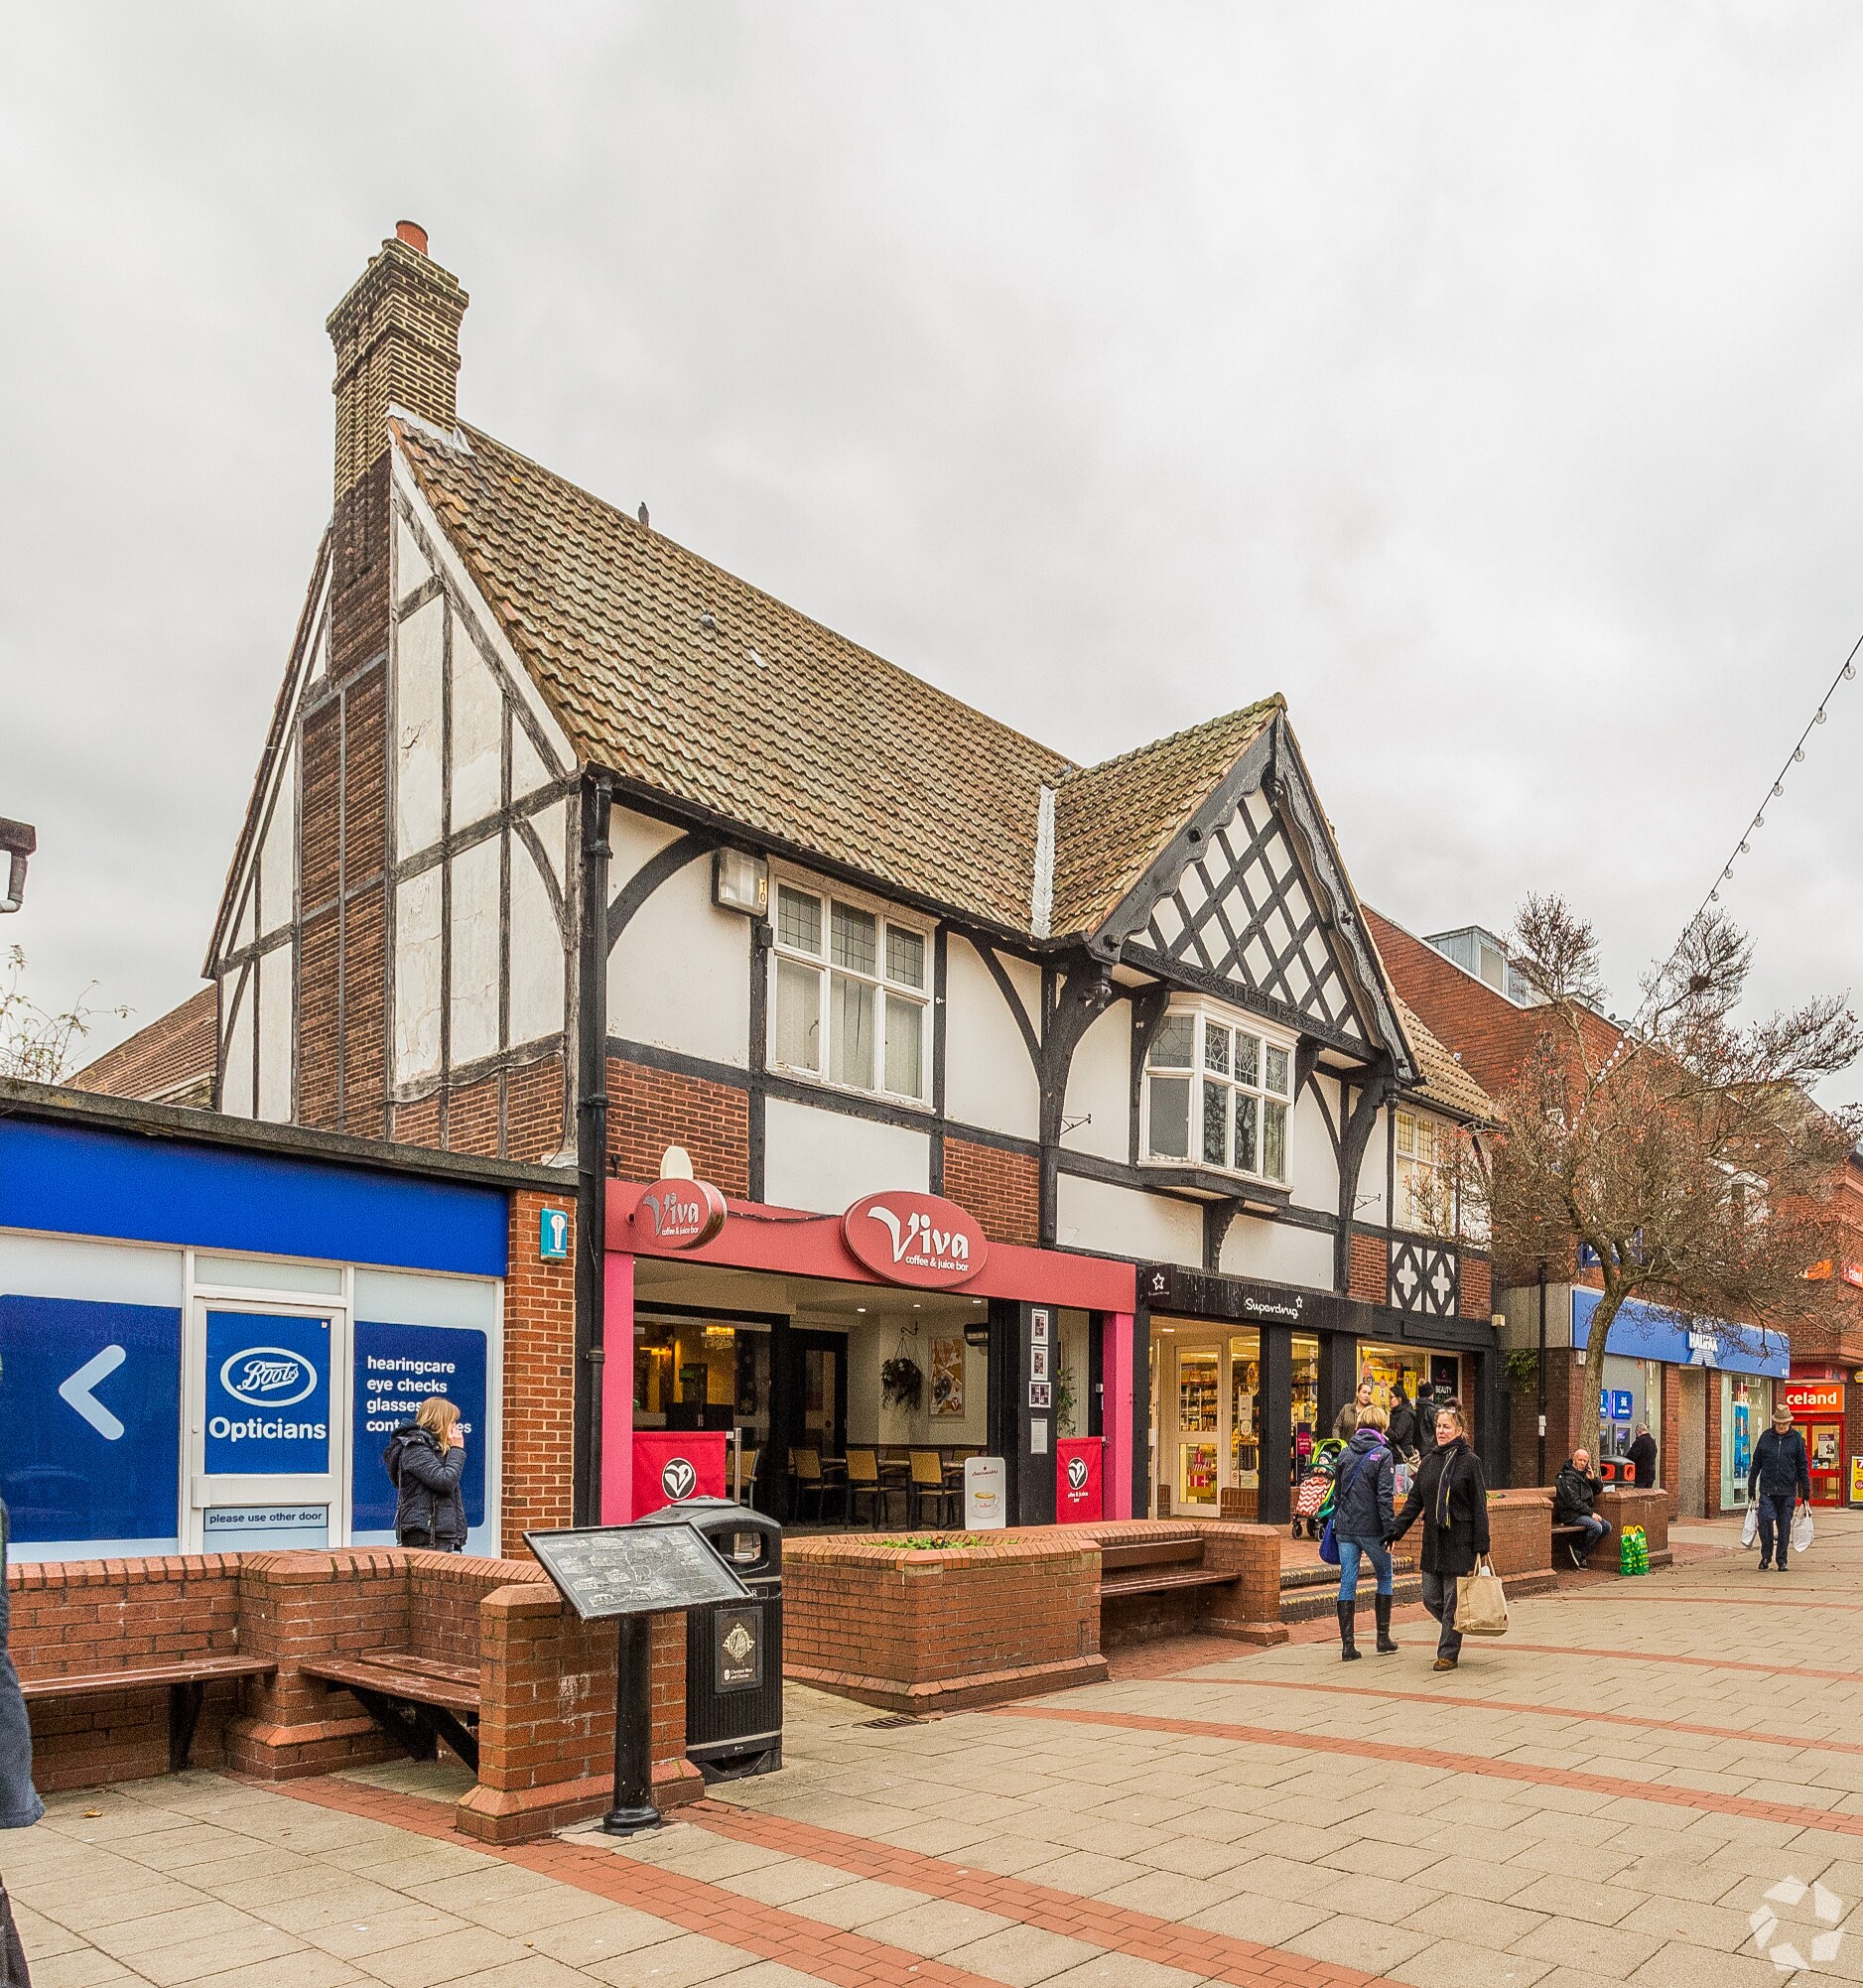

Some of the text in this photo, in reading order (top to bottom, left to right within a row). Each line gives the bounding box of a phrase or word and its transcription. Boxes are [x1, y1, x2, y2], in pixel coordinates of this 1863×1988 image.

[642, 1192, 699, 1236] Viva
[690, 1226, 699, 1235] bar
[866, 1206, 969, 1263] Viva
[905, 1255, 969, 1271] coffee & juice bar
[1245, 1298, 1299, 1319] Superdrug
[367, 1356, 456, 1375] hearingcare
[236, 1360, 299, 1392] Boots
[366, 1378, 448, 1392] eye checks
[1786, 1392, 1837, 1405] celand
[208, 1416, 327, 1442] Opticians
[209, 1515, 244, 1524] please
[269, 1513, 296, 1522] other
[299, 1512, 323, 1521] door
